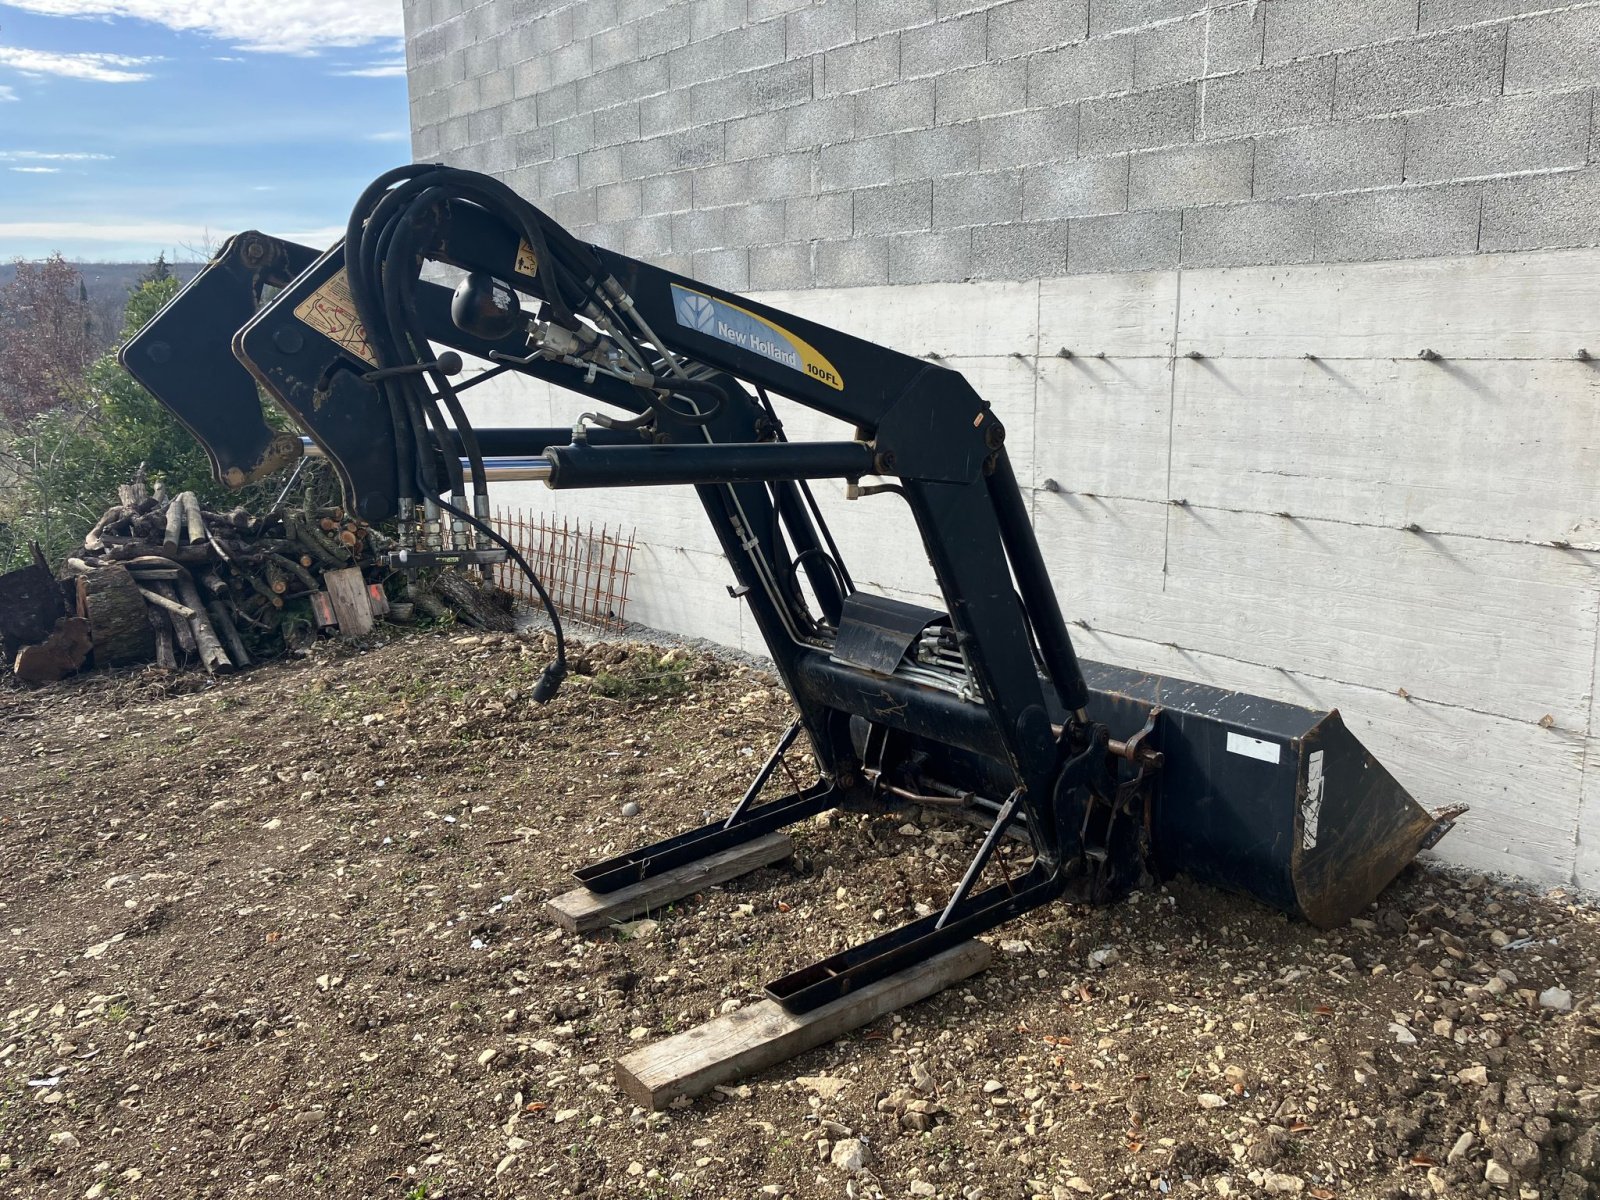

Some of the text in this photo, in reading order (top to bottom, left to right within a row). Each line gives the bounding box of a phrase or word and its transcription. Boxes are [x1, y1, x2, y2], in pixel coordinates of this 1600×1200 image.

[718, 321, 796, 366] New Holland
[807, 363, 838, 386] 100FL
